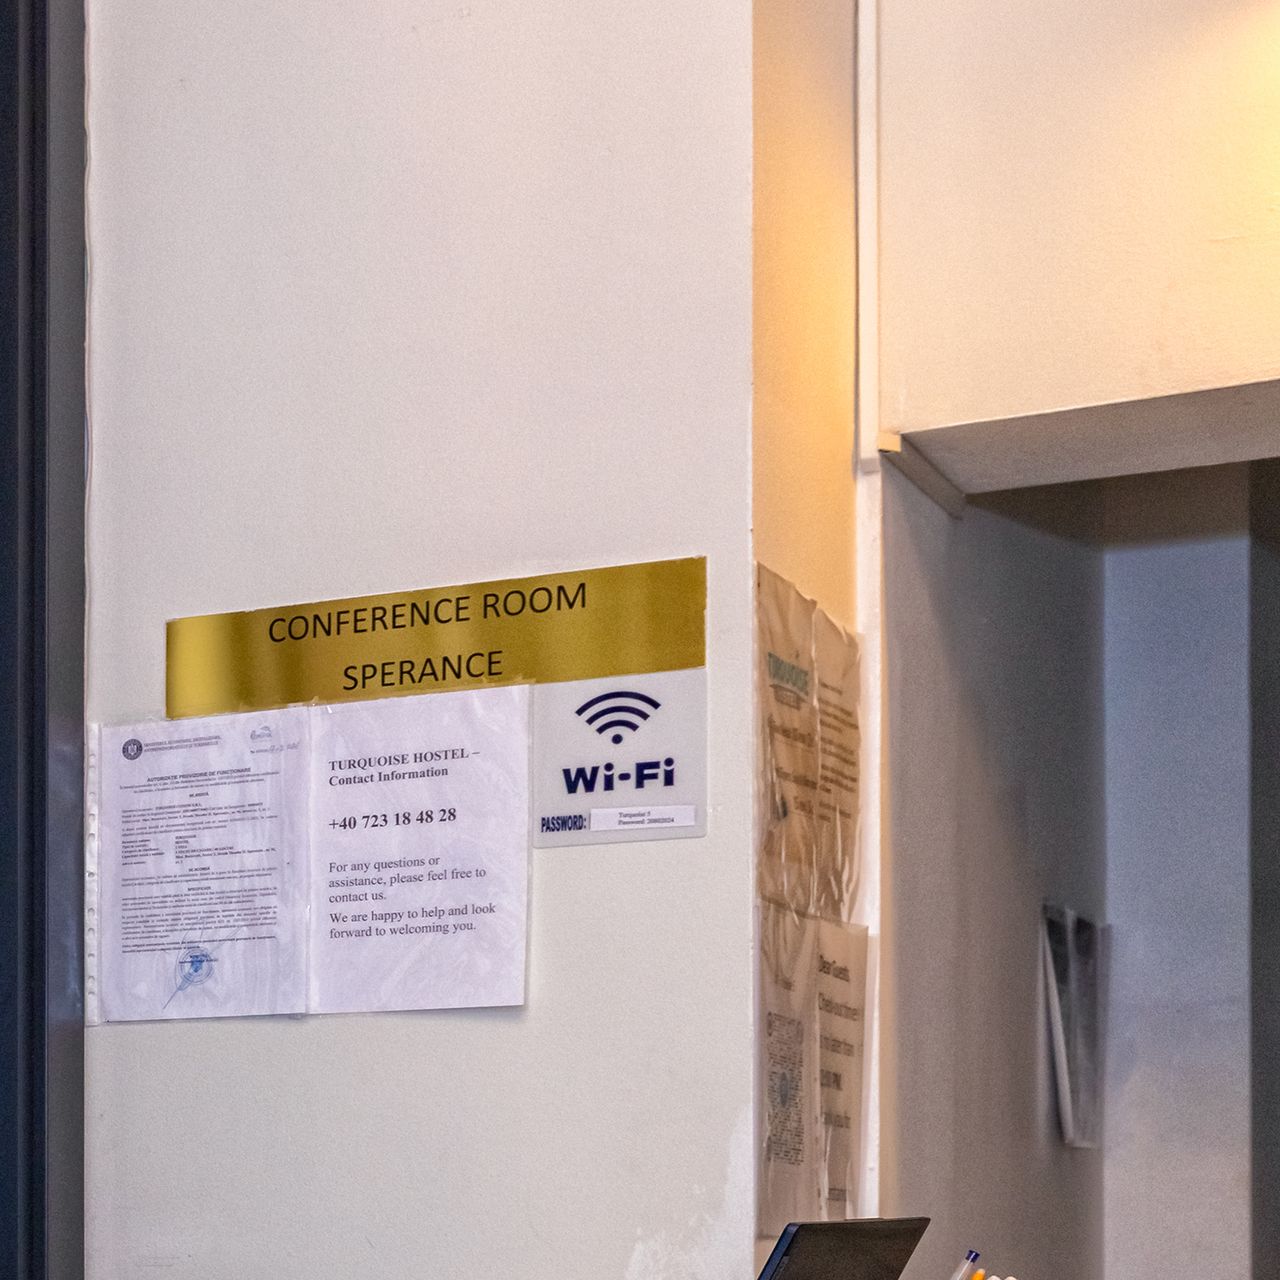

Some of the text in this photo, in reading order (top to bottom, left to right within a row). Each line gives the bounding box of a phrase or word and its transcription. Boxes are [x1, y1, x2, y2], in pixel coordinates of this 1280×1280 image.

[269, 582, 586, 643] CONFERENCE ROOM
[342, 650, 504, 690] SPERANCE
[328, 754, 410, 772] TURQUOISE
[413, 748, 469, 763] HOSTEL
[328, 767, 449, 787] Contact Information
[562, 757, 675, 795] Wi-Fi
[328, 807, 457, 830] +40 723 18 48 28
[541, 814, 587, 833] PASSWORD:
[328, 857, 441, 873] For any questions or
[328, 867, 487, 888] assistance, please feel free to
[328, 891, 387, 903] contact us.
[329, 902, 496, 923] We are happy to help and look
[329, 921, 477, 939] forward to welcoming you.
